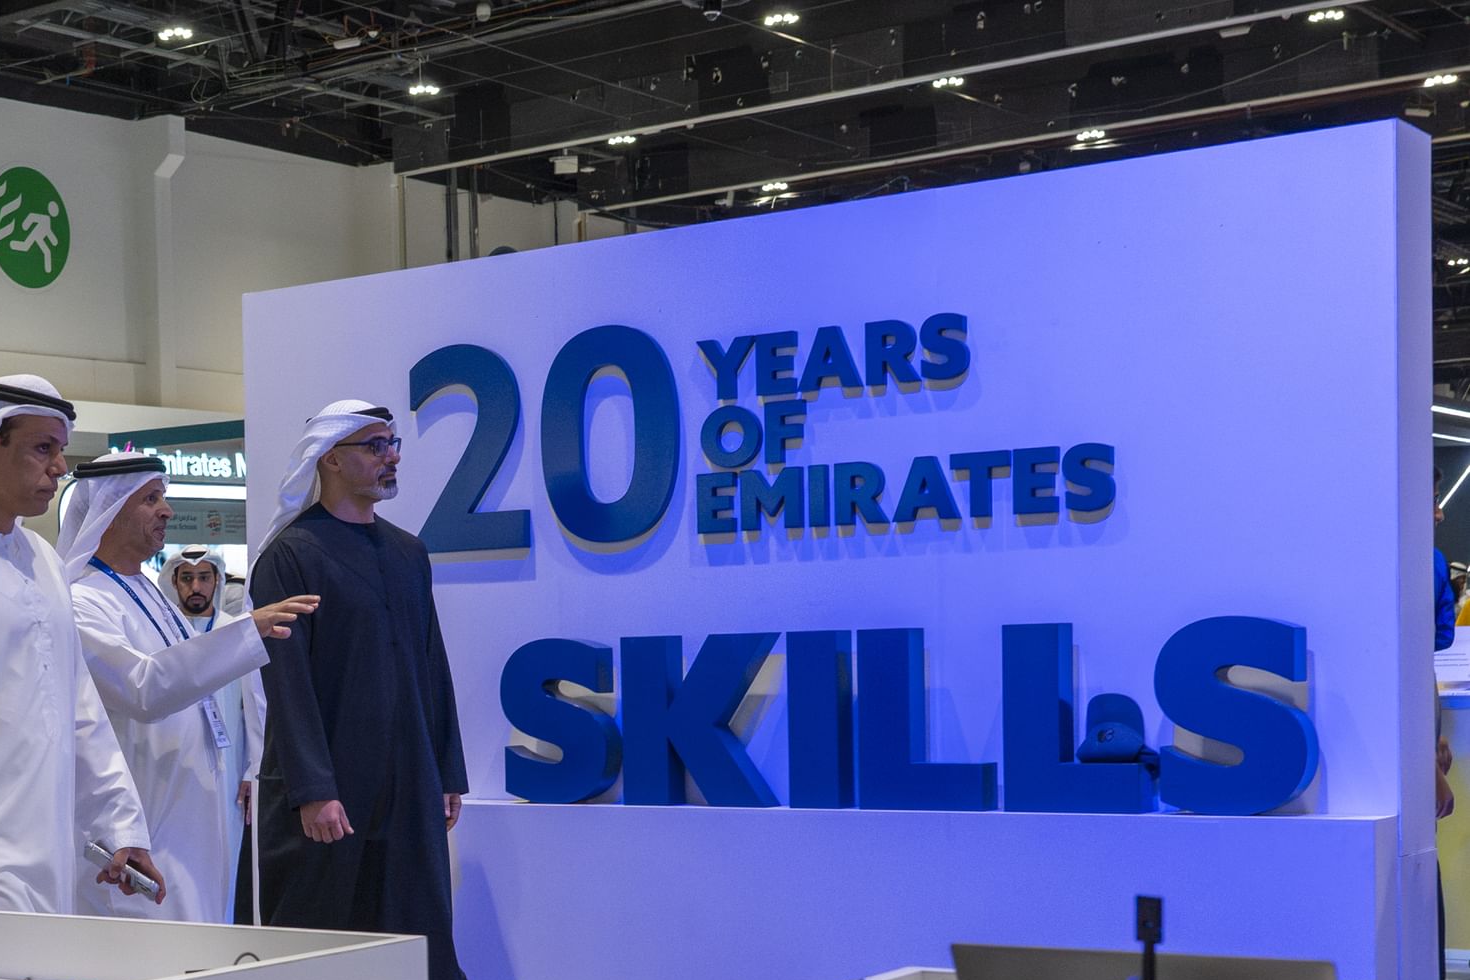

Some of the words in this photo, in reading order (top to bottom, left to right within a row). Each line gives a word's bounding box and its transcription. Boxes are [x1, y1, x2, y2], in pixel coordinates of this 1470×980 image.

[696, 312, 971, 400] YEARS
[409, 324, 681, 553] 20
[700, 399, 807, 468] OF
[696, 442, 1117, 535] EMIRATES
[499, 615, 1318, 816] SKILLS
